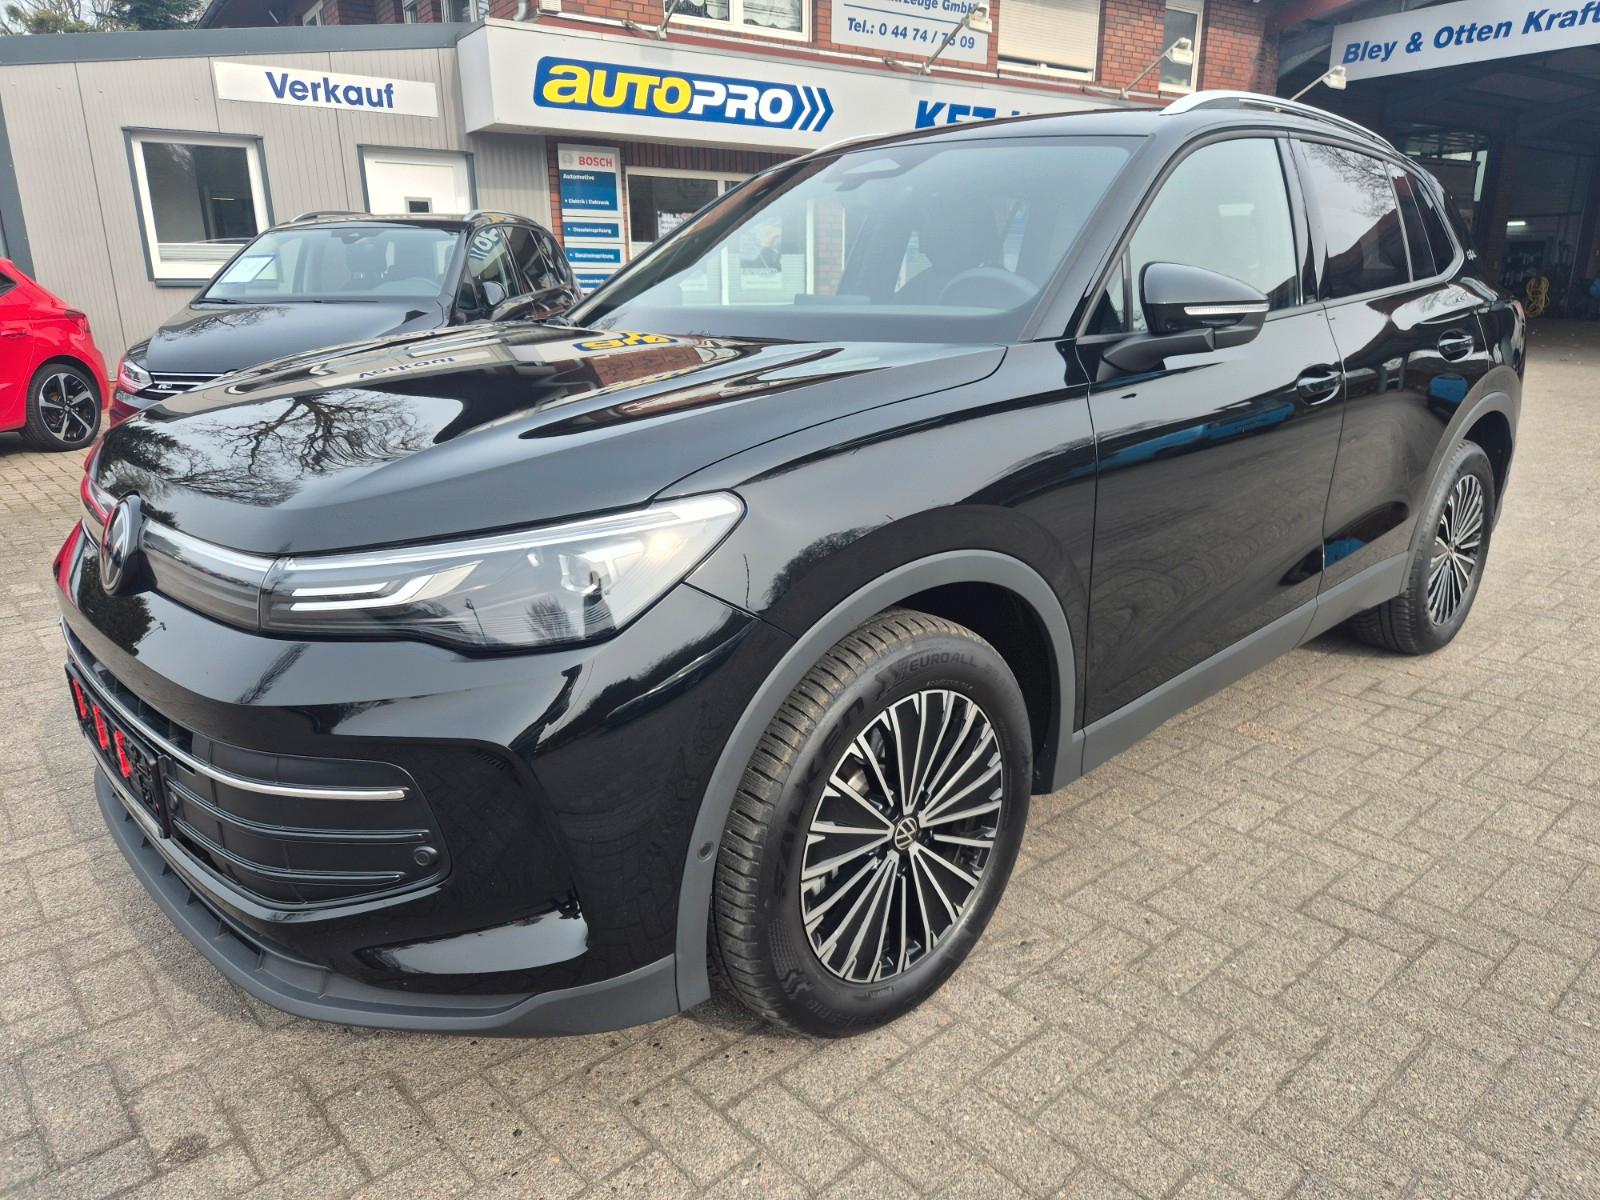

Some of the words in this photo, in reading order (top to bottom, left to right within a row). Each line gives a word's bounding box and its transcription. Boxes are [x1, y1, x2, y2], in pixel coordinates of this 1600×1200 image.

[847, 17, 875, 35] Tel.:
[878, 22, 888, 36] 0
[891, 25, 908, 40] 44
[913, 28, 928, 43] 74
[931, 31, 938, 44] /
[960, 35, 975, 49] 09
[1342, 40, 1398, 64] Bley
[1405, 31, 1424, 54] &
[1433, 20, 1513, 49] Otten
[264, 71, 394, 109] Verkauf
[578, 156, 613, 168] BOSCH
[563, 173, 595, 181] Automotive
[909, 652, 977, 673] EUROALL
